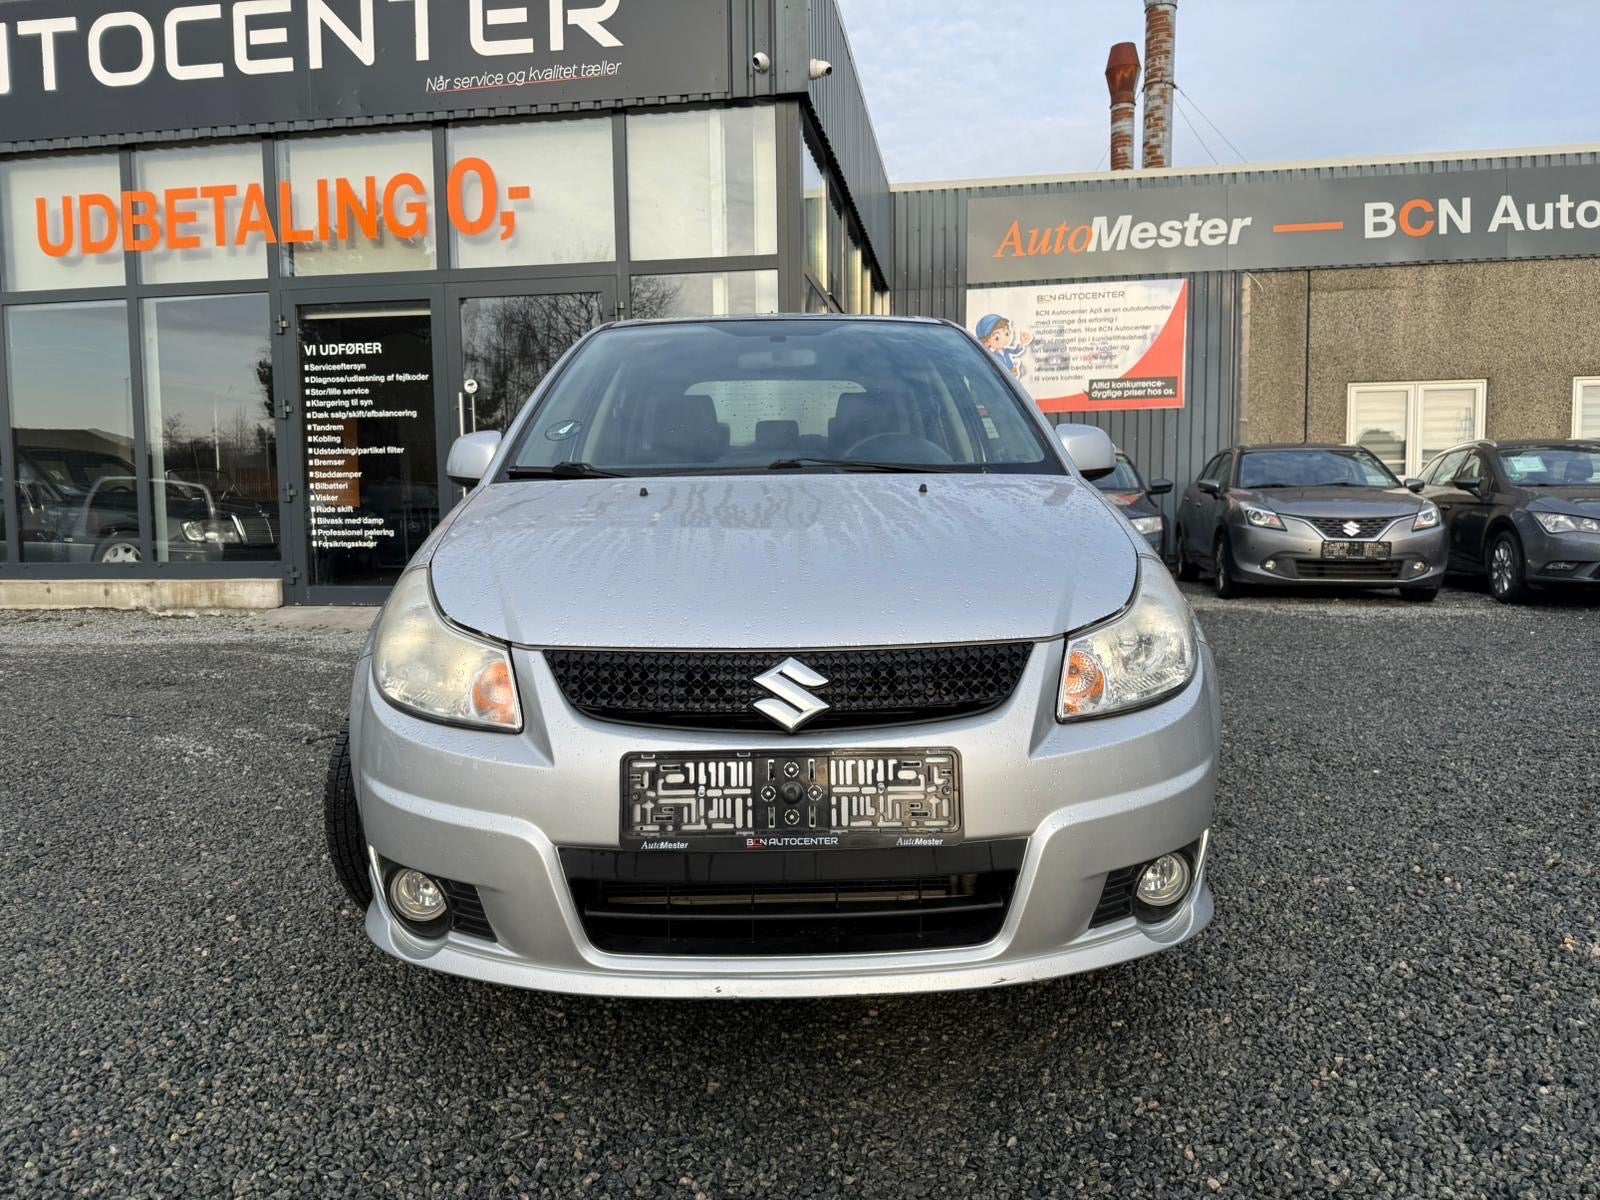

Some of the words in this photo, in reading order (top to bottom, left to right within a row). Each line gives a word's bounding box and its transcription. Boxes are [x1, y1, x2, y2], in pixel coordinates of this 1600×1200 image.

[0, 0, 624, 94] TOCENTER
[425, 74, 450, 92] Når
[453, 71, 504, 89] service
[506, 70, 526, 86] og
[528, 63, 578, 81] kvalitet
[580, 60, 622, 77] tæller
[35, 172, 430, 259] UDBETALING
[446, 157, 531, 241] 0,-
[1363, 197, 1472, 240] BCN
[1487, 194, 1600, 233] Auto
[992, 212, 1252, 259] AutoMester
[1057, 291, 1126, 302] AUTOCENTER
[1035, 309, 1050, 317] BCN
[1051, 308, 1088, 316] Autocenter
[1114, 324, 1151, 332] Autocenter
[304, 345, 316, 356] VI
[320, 342, 382, 356] UDFØRER
[310, 363, 367, 372] Serviceeftersyn
[310, 374, 385, 384] Diagnose/udlæsning
[386, 373, 394, 381] af
[1091, 381, 1110, 390] Altid
[1111, 380, 1166, 389] konkurrence-
[310, 388, 341, 396] Stor/lille
[342, 387, 370, 395] service
[1091, 389, 1122, 399] dygtige
[1123, 388, 1146, 397] priser
[1147, 388, 1162, 396] hos
[1163, 388, 1175, 396] os.
[359, 399, 373, 408] syn
[312, 411, 329, 419] Dæk
[313, 435, 341, 444] Kobling
[387, 446, 405, 454] filter
[315, 482, 348, 490] Bilbatteri
[315, 494, 338, 502] Visker
[337, 505, 354, 513] skift
[317, 517, 343, 525] Bilvask
[363, 517, 384, 526] damp
[318, 540, 378, 549] Forsikringsskader
[640, 841, 689, 850] AutoMester
[768, 836, 839, 846] AUTOCENTER
[895, 837, 944, 846] AutoMester
